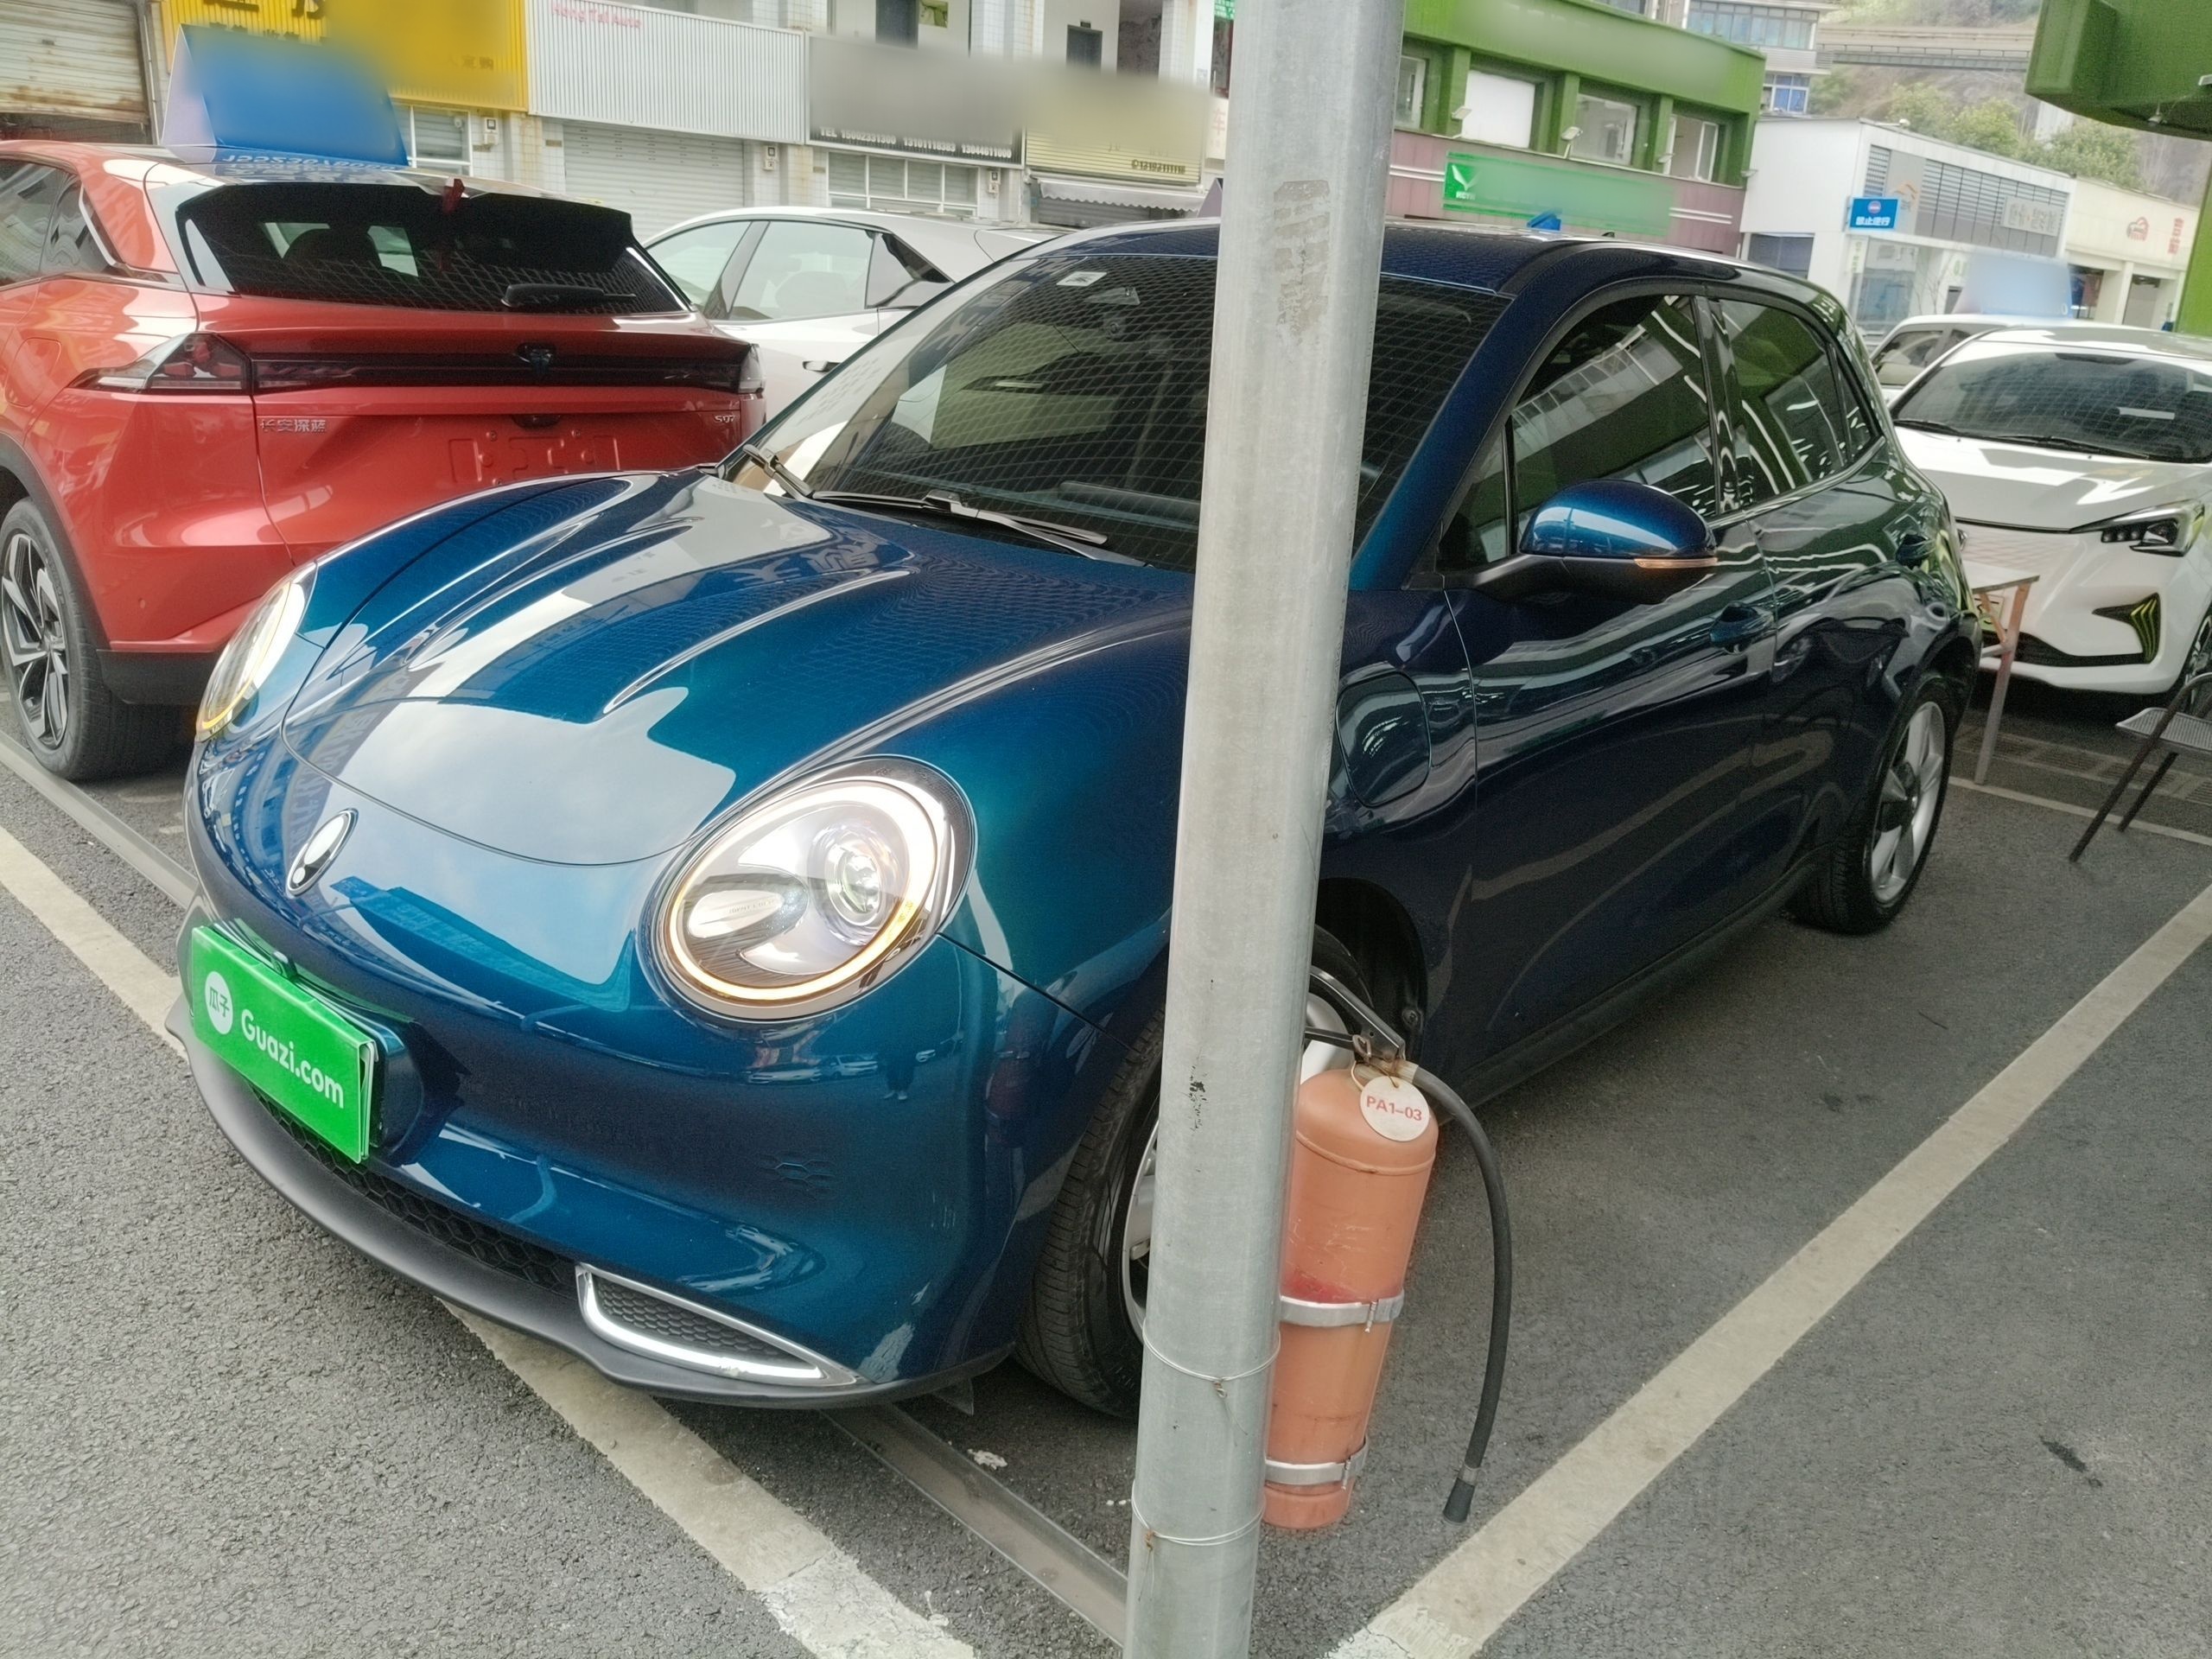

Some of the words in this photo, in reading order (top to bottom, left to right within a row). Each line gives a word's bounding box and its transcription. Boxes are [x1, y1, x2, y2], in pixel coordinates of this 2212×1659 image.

[820, 126, 837, 137] TEL
[260, 418, 326, 433] 长安深蓝
[209, 986, 230, 1018] 瓜子
[241, 1008, 344, 1109] Guazi.com
[1366, 1095, 1422, 1122] PA1-03
